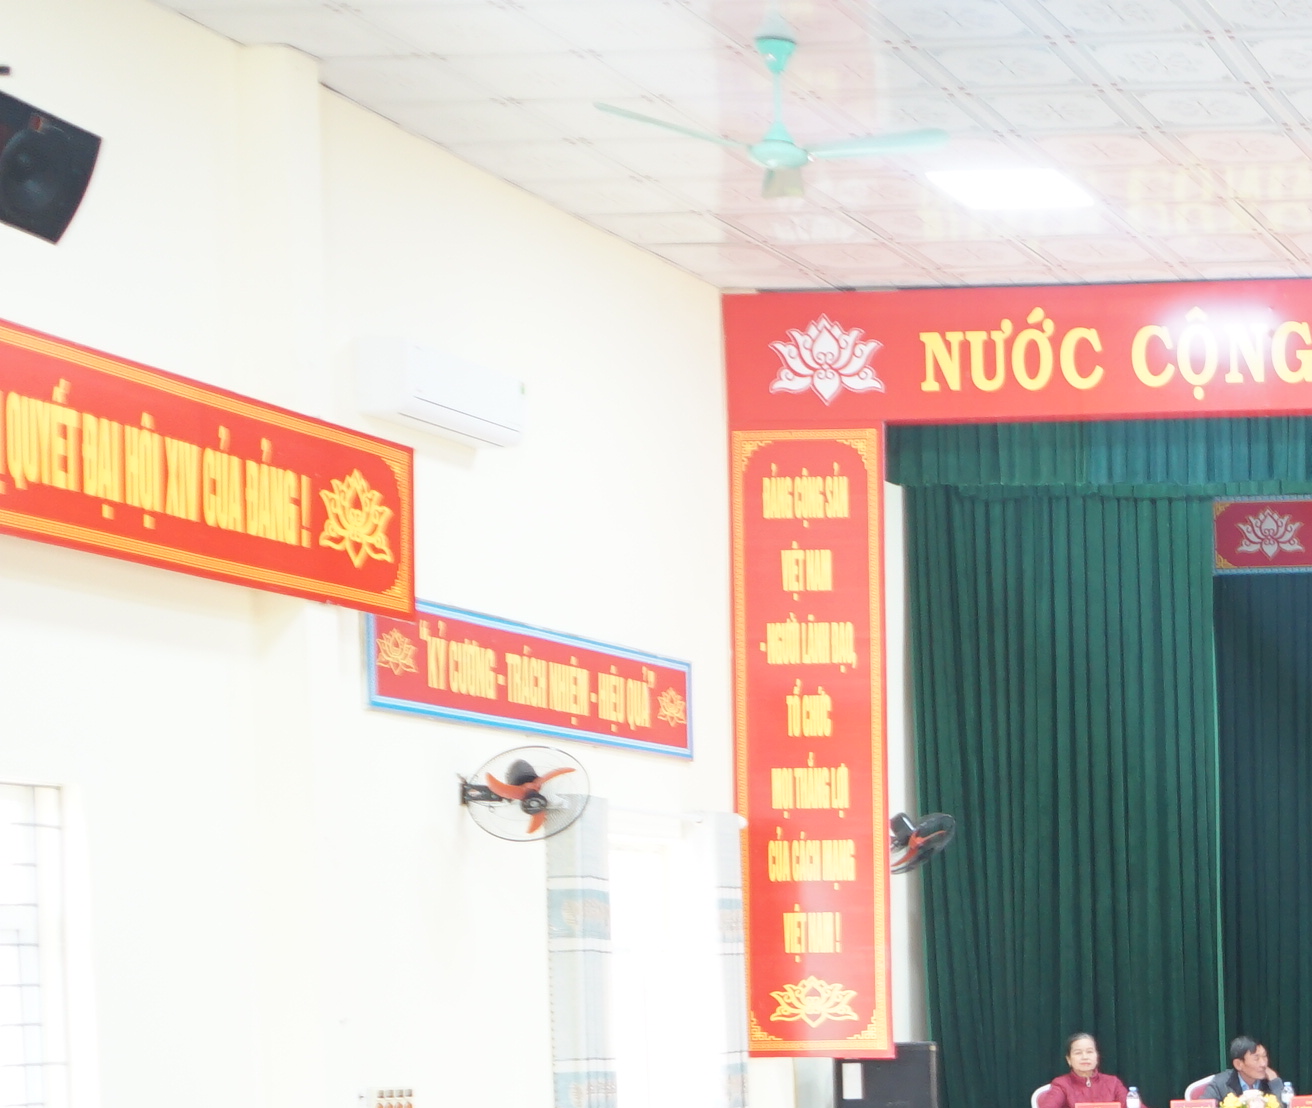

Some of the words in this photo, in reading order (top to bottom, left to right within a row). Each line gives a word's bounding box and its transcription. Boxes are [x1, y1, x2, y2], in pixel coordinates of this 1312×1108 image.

[920, 307, 1104, 392] NƯỚC
[6, 378, 82, 492] QUYẾT
[82, 411, 124, 520] ĐẠI
[124, 412, 165, 530] HỘI
[164, 436, 202, 522] XIV
[203, 425, 245, 533] CỦA
[762, 463, 793, 519] ĐẢNG
[794, 467, 825, 528] CỘNG
[825, 462, 849, 519] SẢN
[781, 541, 805, 601] VIỆT
[806, 549, 833, 592] NAM
[505, 645, 548, 709] TRÁCH
[548, 655, 590, 726] NHIỆM
[598, 664, 625, 732] HIỆU
[786, 679, 801, 737] TỔ
[768, 827, 791, 882] CỦA
[791, 831, 821, 882] CÁCH
[821, 839, 856, 890] MẠNG
[783, 903, 807, 963] VIỆT
